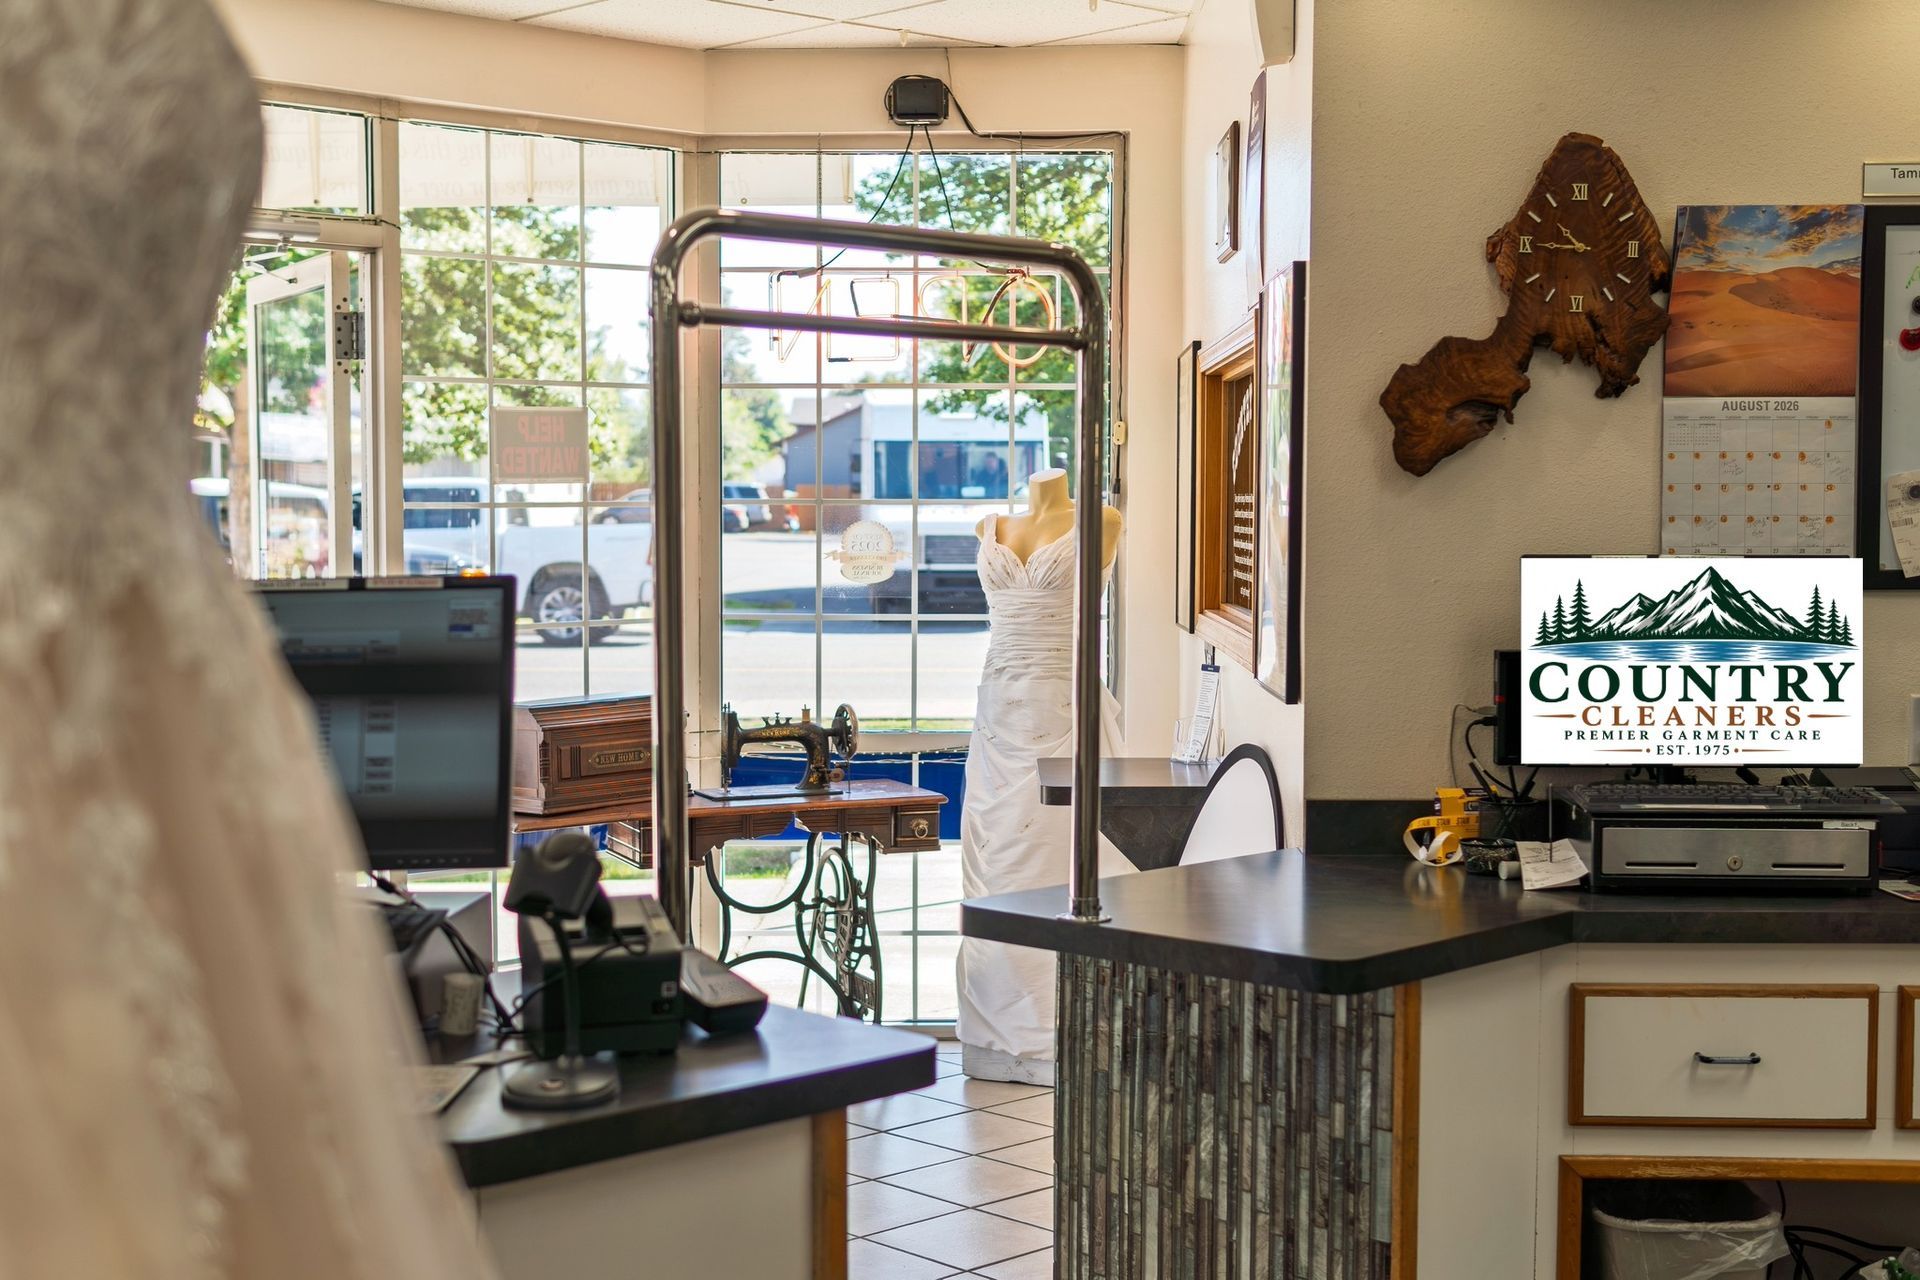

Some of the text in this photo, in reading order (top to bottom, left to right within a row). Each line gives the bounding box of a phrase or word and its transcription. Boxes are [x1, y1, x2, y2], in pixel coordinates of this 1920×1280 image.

[1890, 167, 1920, 179] Tam
[1571, 183, 1588, 200] XII
[1519, 236, 1532, 253] IX
[1628, 240, 1639, 258] III
[1569, 295, 1583, 312] VI
[1721, 400, 1799, 412] AUGUST 2026
[1528, 661, 1855, 703] COUNTRY
[1581, 705, 1801, 727] CLEANERS
[1564, 729, 1822, 741] PREMIER GARMENT CARE
